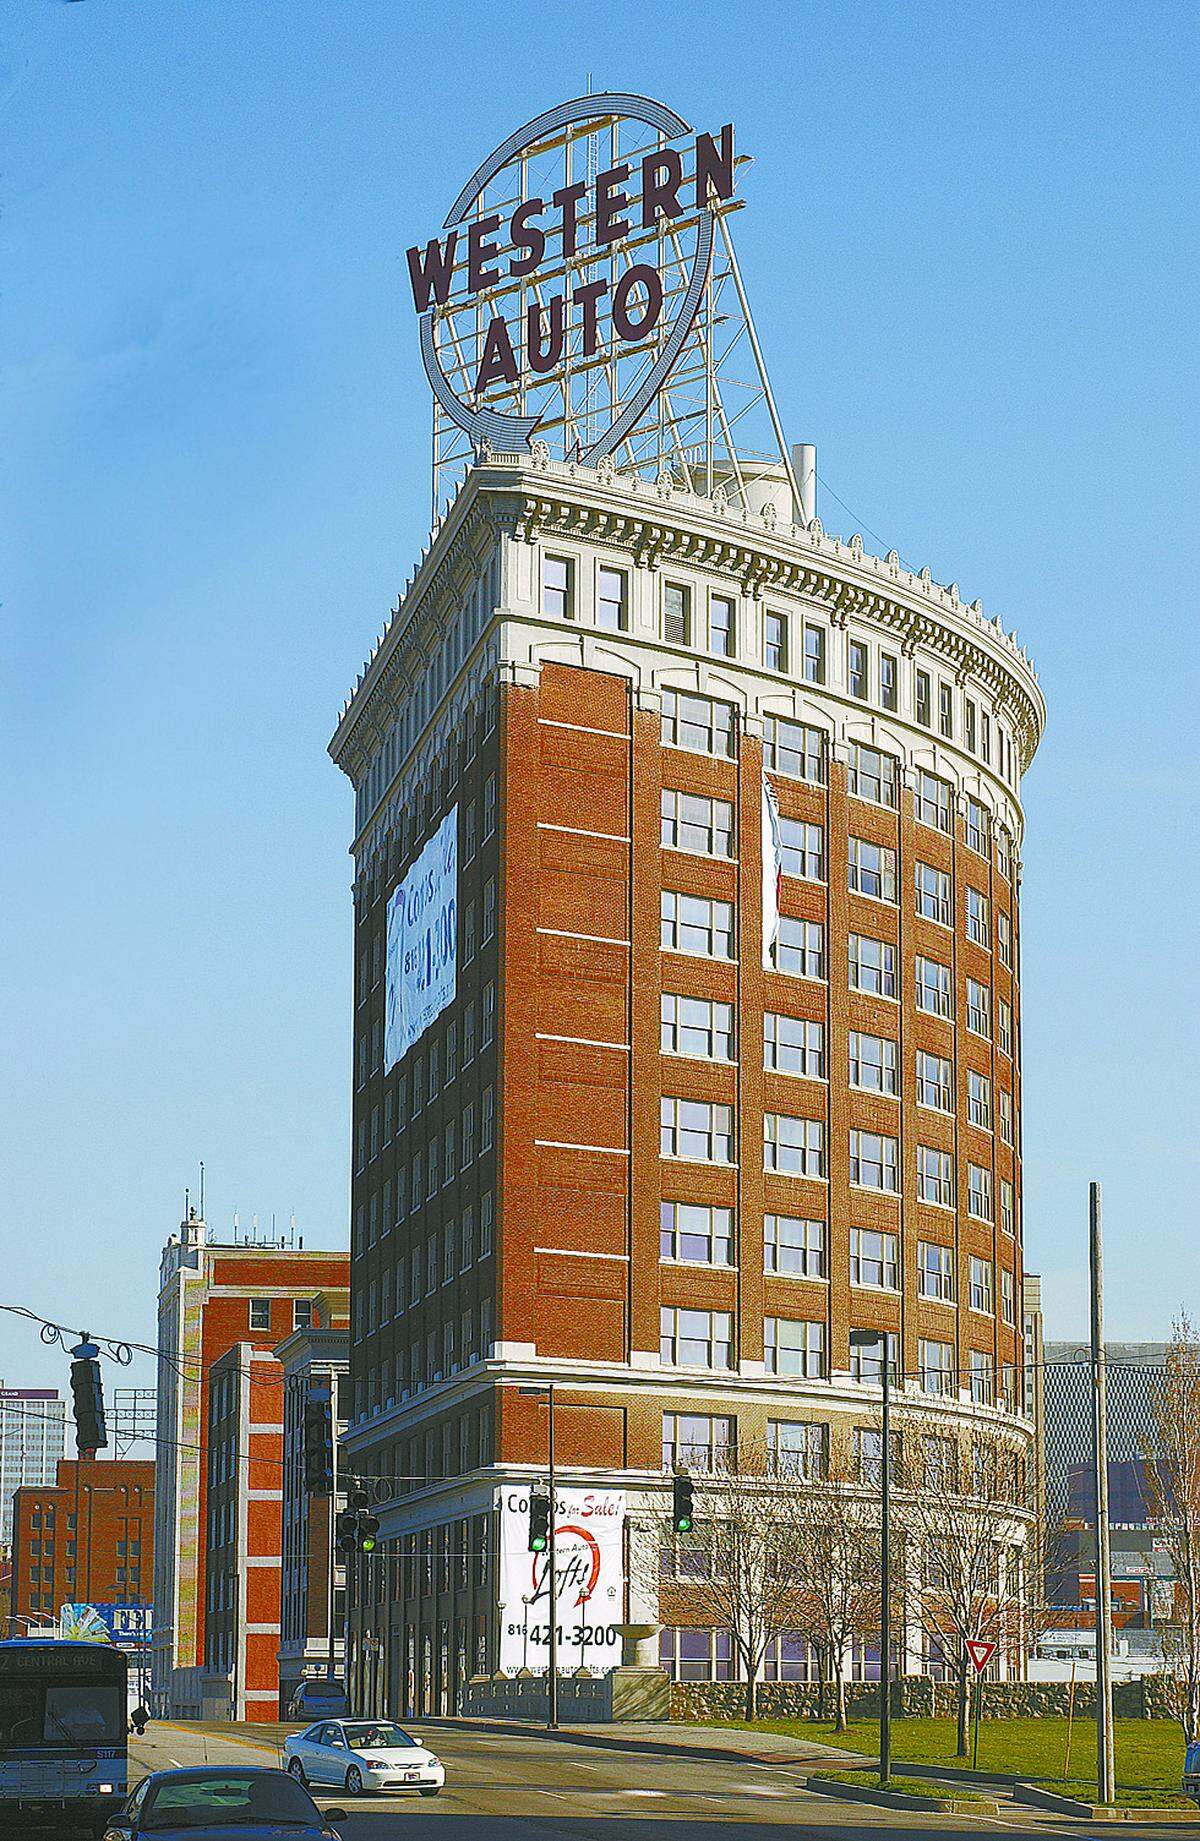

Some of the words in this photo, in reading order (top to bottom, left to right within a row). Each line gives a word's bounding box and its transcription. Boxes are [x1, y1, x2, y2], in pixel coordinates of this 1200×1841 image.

[406, 123, 733, 314] WESTERN
[475, 264, 663, 394] AUTO
[507, 1494, 567, 1514] Coos
[581, 1495, 623, 1517] Sale!
[529, 1554, 590, 1605] Lofts
[508, 1624, 528, 1636] 816
[530, 1625, 617, 1646] 421-3200
